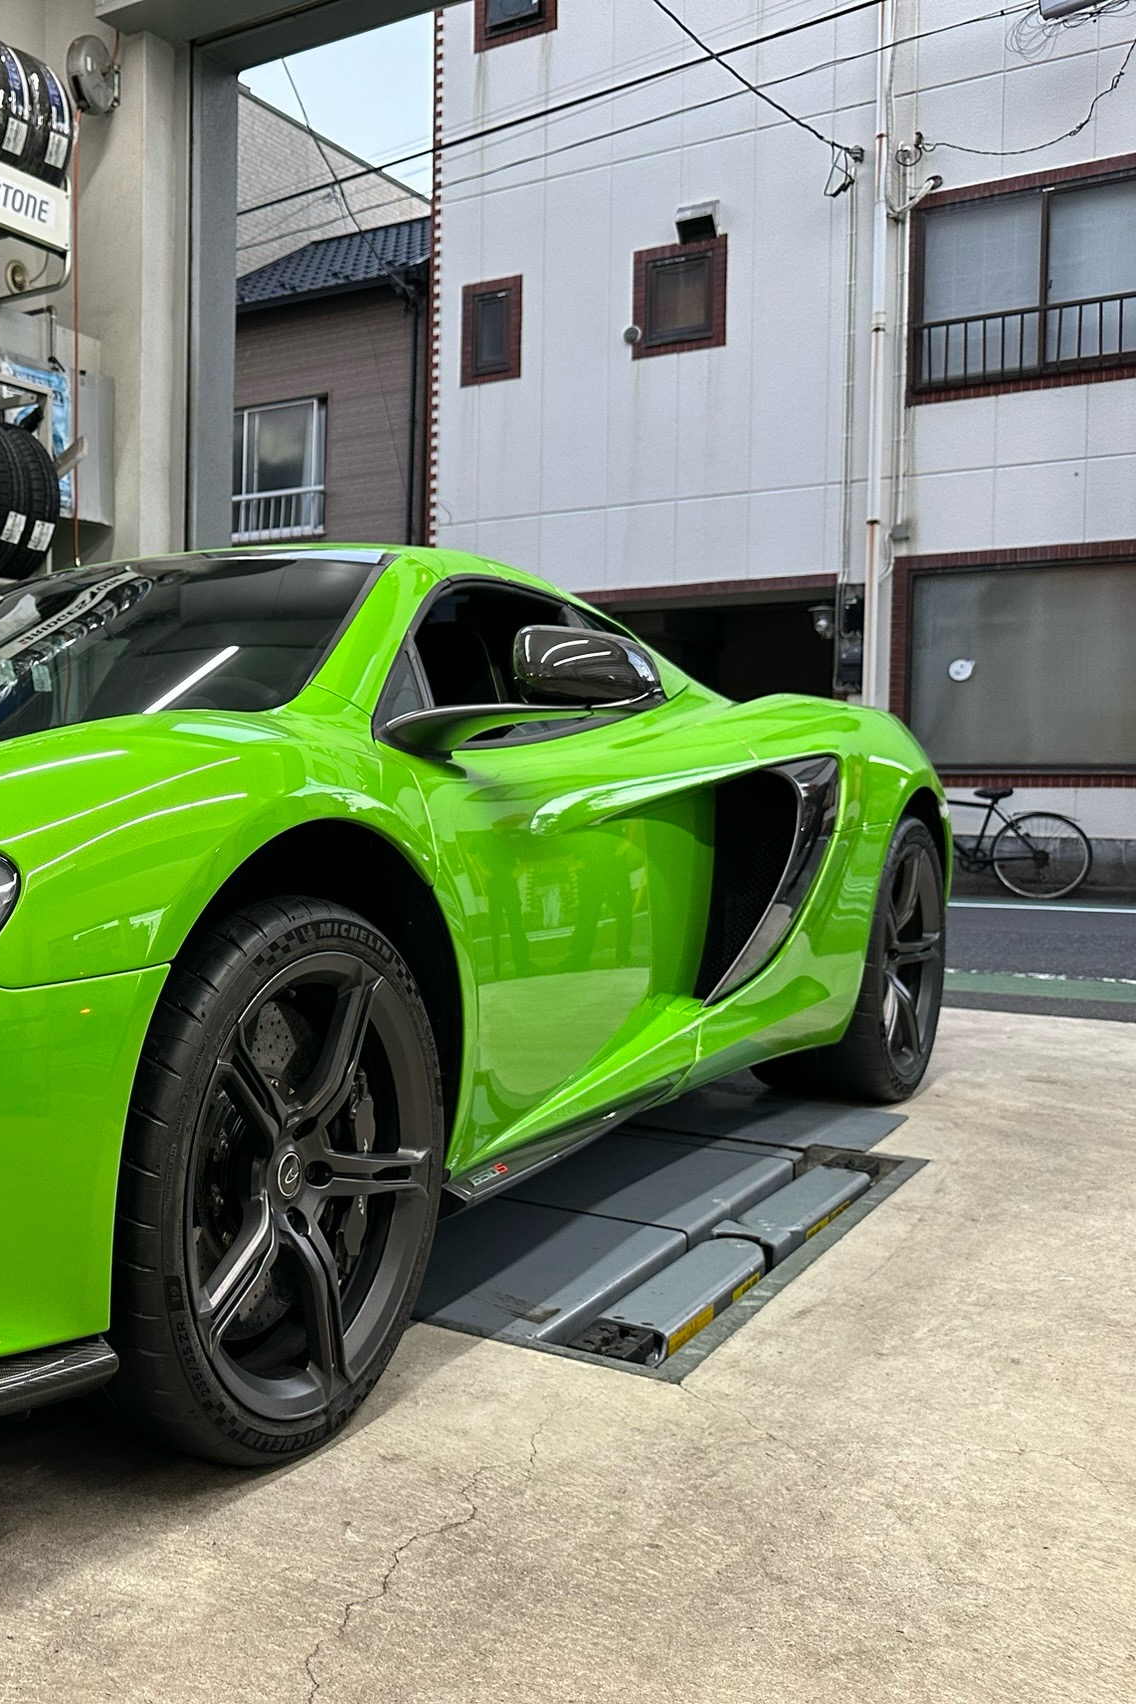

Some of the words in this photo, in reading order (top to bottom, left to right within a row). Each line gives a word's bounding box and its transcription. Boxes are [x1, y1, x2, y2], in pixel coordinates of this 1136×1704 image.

[319, 922, 393, 962] MICHELIN
[170, 1285, 180, 1304] 19
[176, 1320, 188, 1346] ZR
[184, 1348, 212, 1396] 235/35
